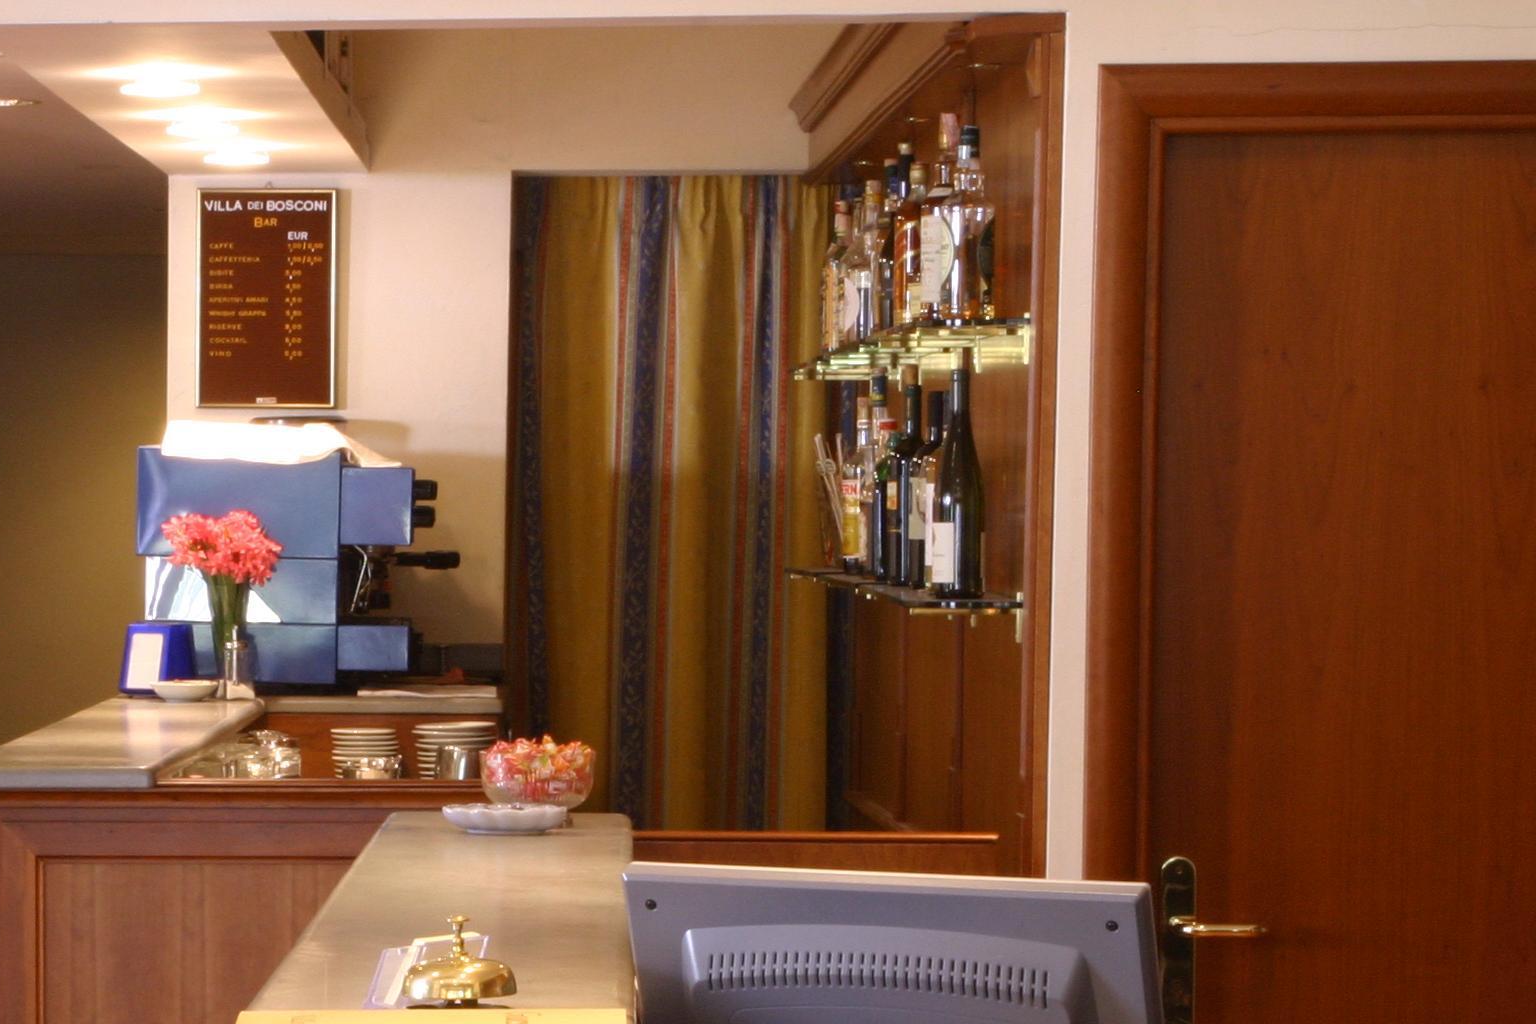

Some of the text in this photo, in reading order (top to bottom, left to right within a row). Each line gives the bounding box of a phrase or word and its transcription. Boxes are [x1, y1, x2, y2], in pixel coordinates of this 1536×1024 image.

[204, 199, 327, 212] VILLA DEI BOSCONI
[287, 231, 309, 241] EUR
